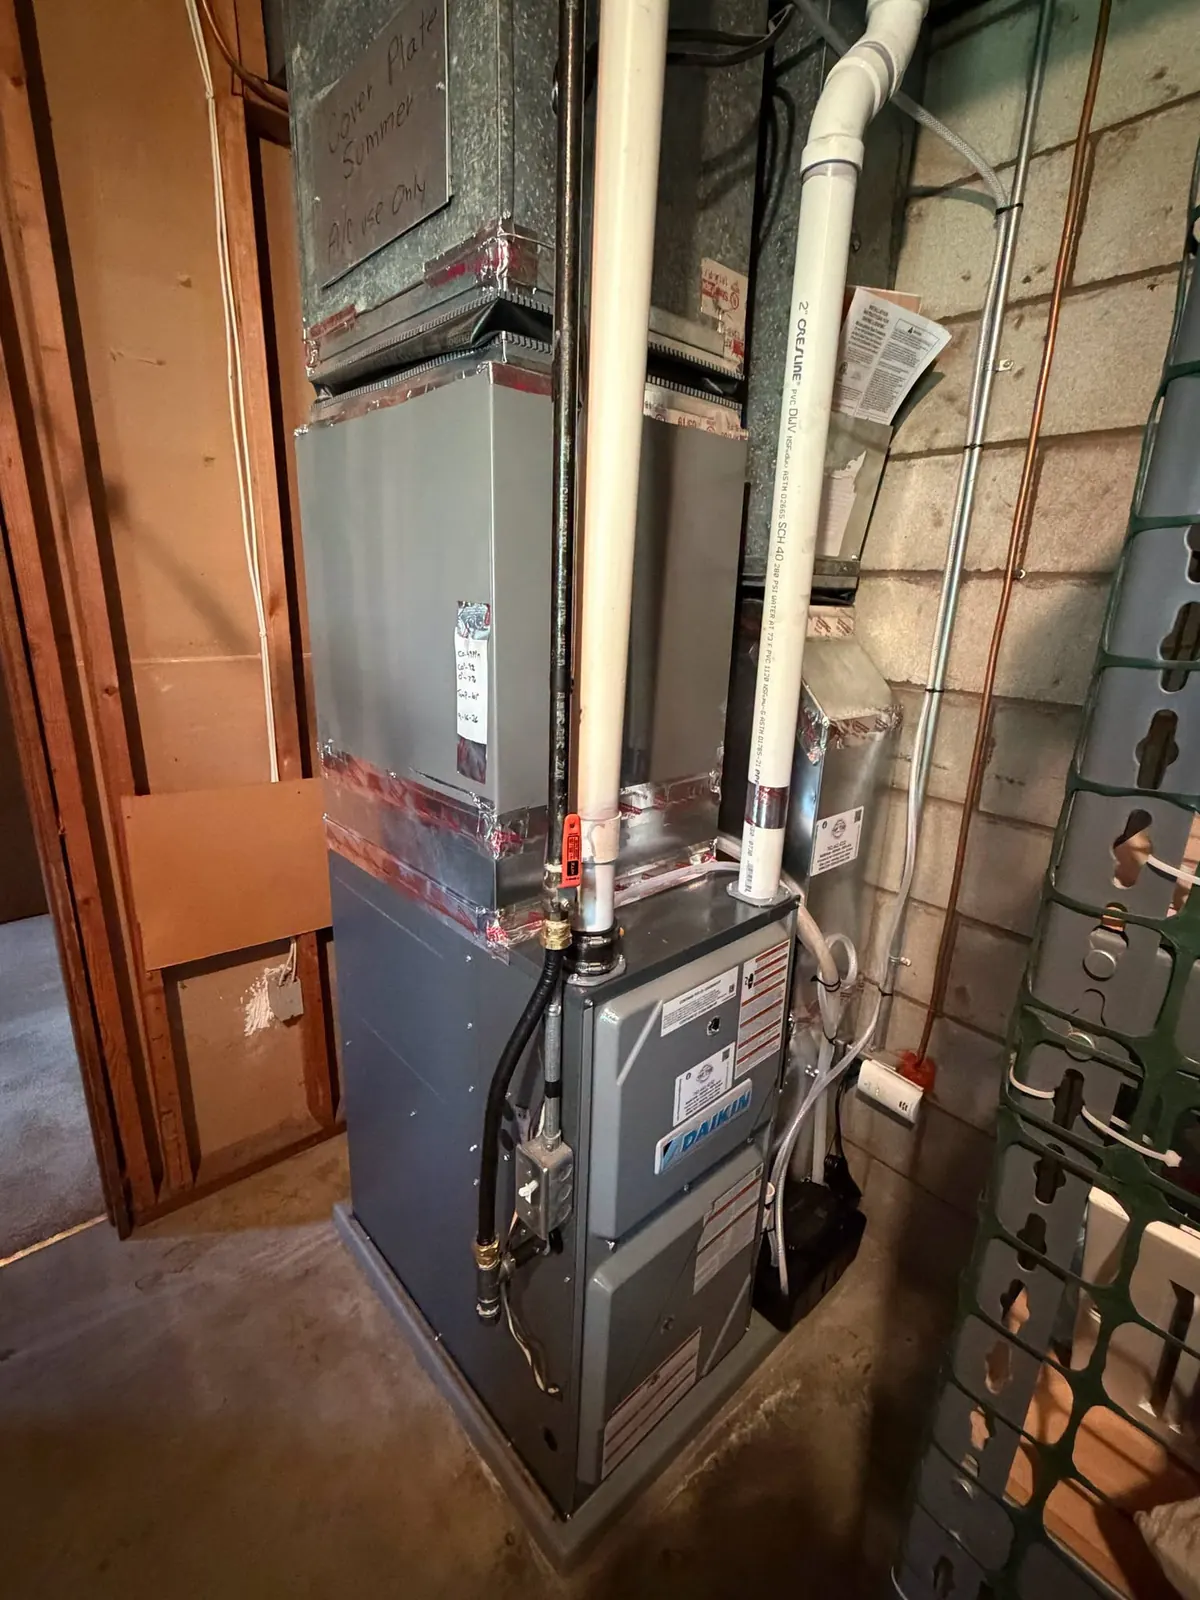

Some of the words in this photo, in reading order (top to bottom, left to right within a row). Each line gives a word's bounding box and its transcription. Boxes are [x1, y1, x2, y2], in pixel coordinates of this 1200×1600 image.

[328, 84, 372, 154] Cover
[387, 7, 437, 86] Plate
[343, 94, 413, 180] Summer
[392, 174, 426, 216] Only
[789, 388, 798, 406] PVC
[787, 408, 799, 434] DWV
[781, 470, 790, 492] ASTM
[777, 521, 787, 544] SCH
[774, 546, 785, 562] 40
[771, 580, 779, 593] PSI
[769, 595, 777, 619] WATER
[768, 620, 775, 630] AT
[764, 649, 772, 664] PVC
[680, 1089, 752, 1154] DAIKIN
